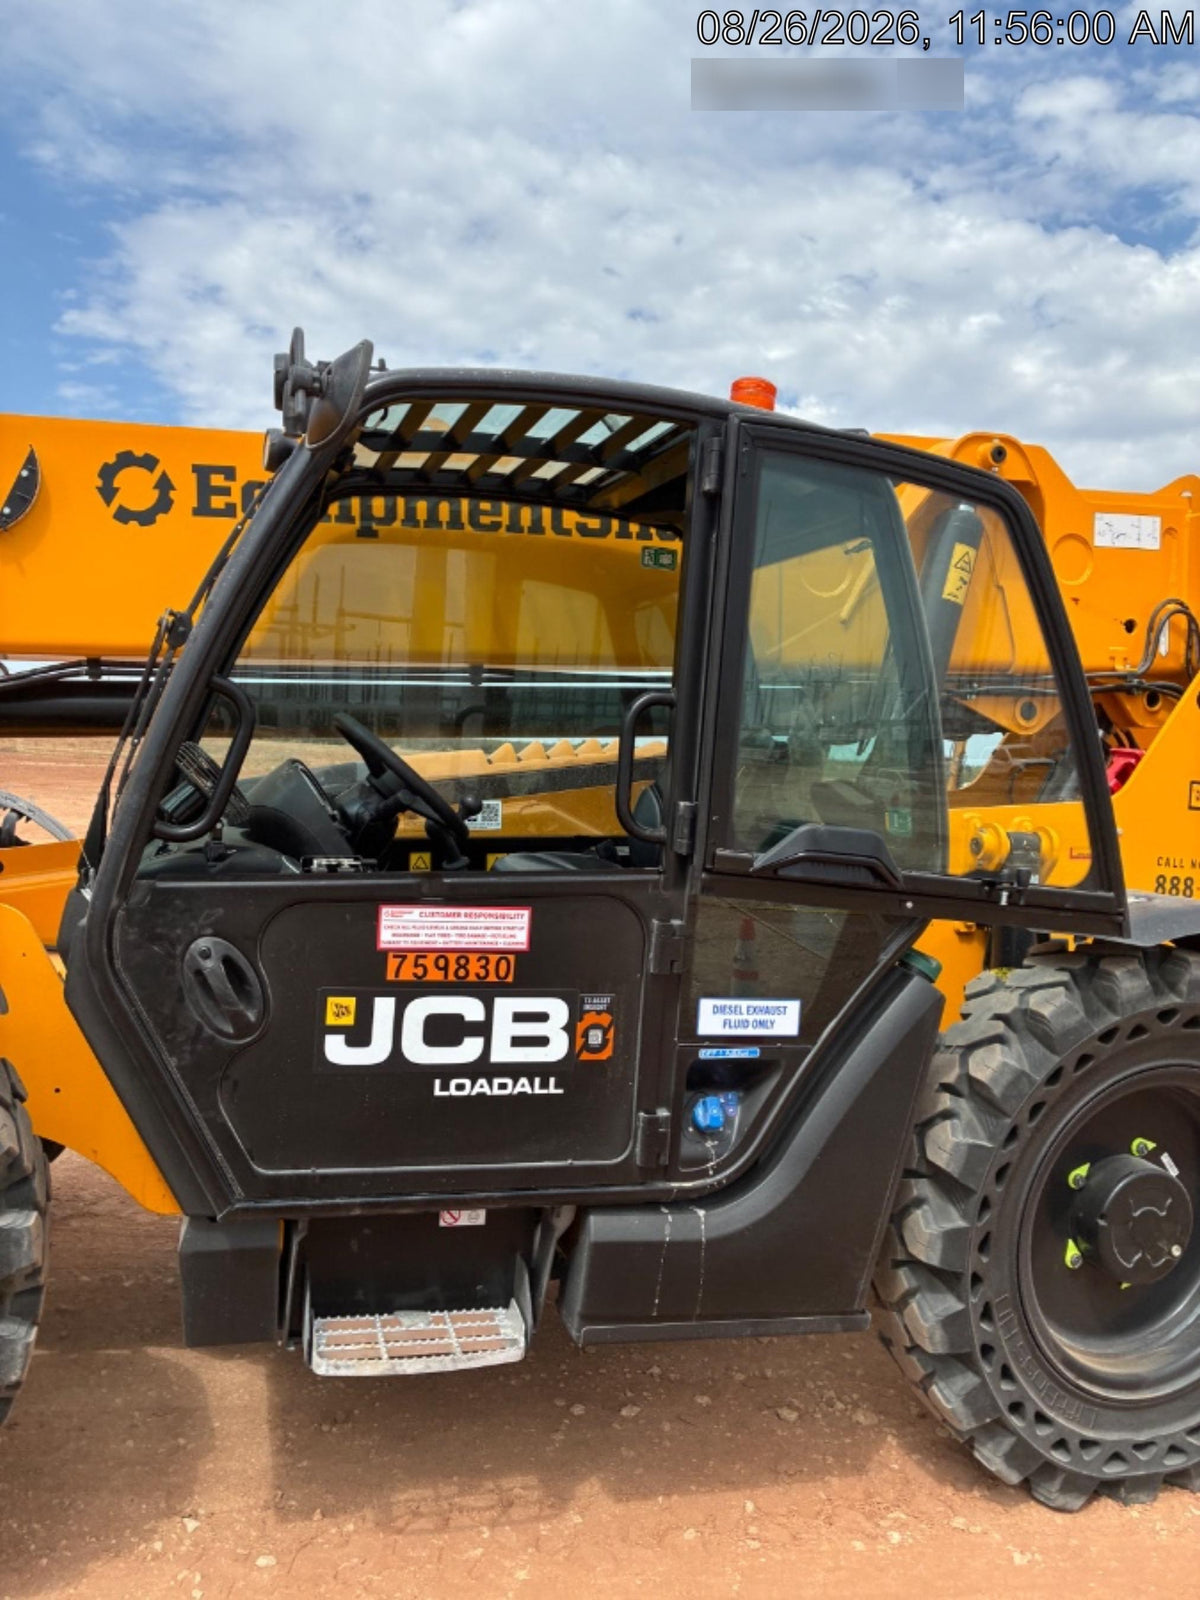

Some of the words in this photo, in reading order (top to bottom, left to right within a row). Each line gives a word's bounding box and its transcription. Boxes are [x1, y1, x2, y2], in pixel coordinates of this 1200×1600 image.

[1157, 856, 1185, 868] CALL
[419, 911, 462, 919] CUSTOMER
[464, 912, 525, 920] RESPONSIBILITY
[392, 954, 511, 981] 759830
[712, 1004, 743, 1015] DIESEL
[746, 1005, 788, 1016] EXHAUST
[723, 1018, 750, 1029] FLUID
[752, 1019, 776, 1029] ONLY
[324, 995, 569, 1066] JCB
[433, 1077, 564, 1096] LOADALL
